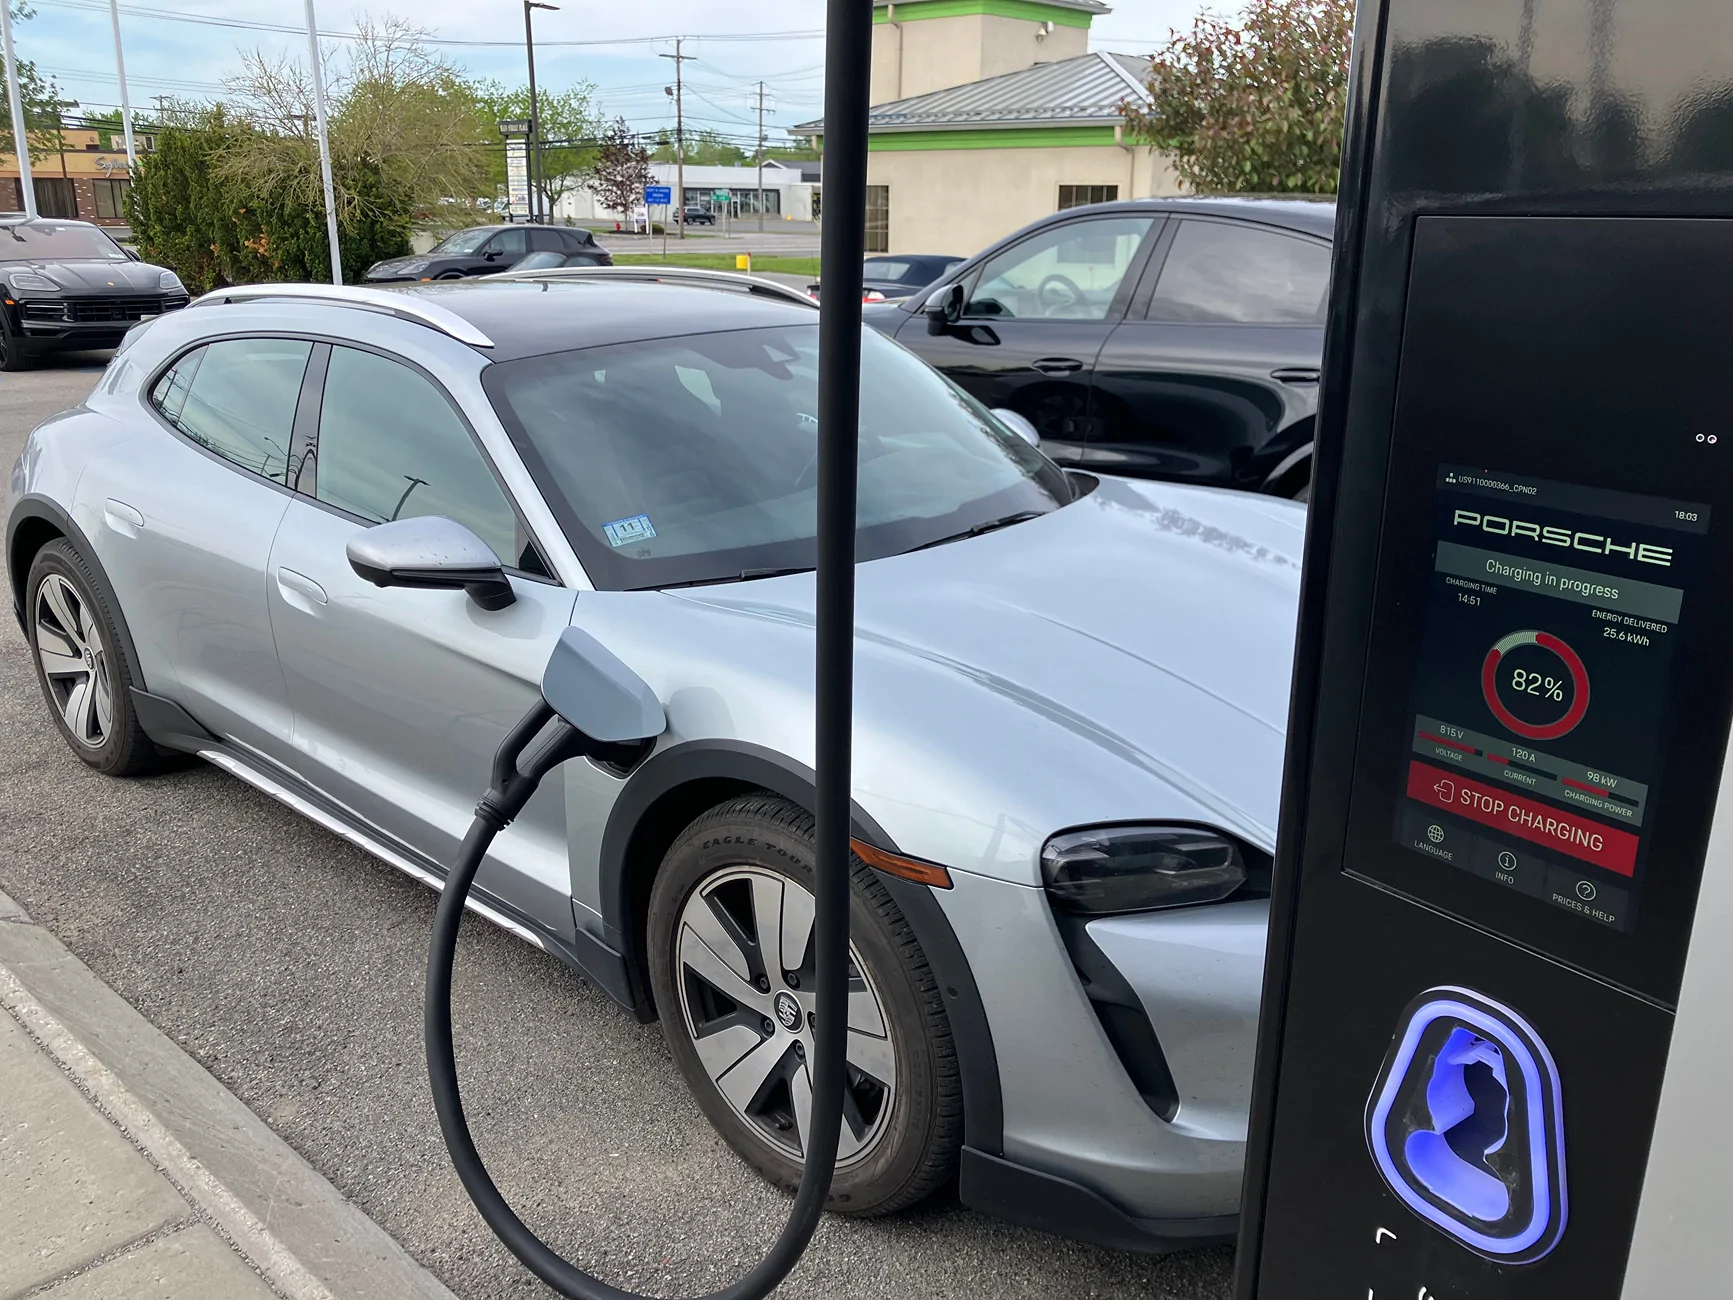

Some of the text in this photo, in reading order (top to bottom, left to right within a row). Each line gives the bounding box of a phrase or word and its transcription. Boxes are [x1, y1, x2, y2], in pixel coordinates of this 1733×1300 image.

[1675, 510, 1698, 522] 18:03
[1453, 509, 1673, 566] PORSCHE
[1445, 577, 1497, 594] CHARGING TIME
[1486, 559, 1619, 600] Charging in progress
[1457, 593, 1481, 606] 14:51
[1592, 610, 1668, 634] ENERGY DELIVERED
[1603, 627, 1650, 646] 25.6 kWh
[1512, 669, 1564, 701] 82%
[1440, 725, 1464, 740] 815 V
[1435, 747, 1463, 762] VOLTAGE
[1512, 748, 1536, 763] 120 A
[1504, 770, 1536, 786] CURRENT
[1587, 771, 1617, 789] 98 kW
[1564, 789, 1633, 818] CHARGING POWER
[1460, 789, 1604, 852] STOP CHARGING
[703, 836, 757, 850] EAGLE
[1414, 840, 1453, 861] LANGUAGE
[1495, 871, 1515, 885] INFO
[1552, 893, 1615, 924] PRICES & HELP
